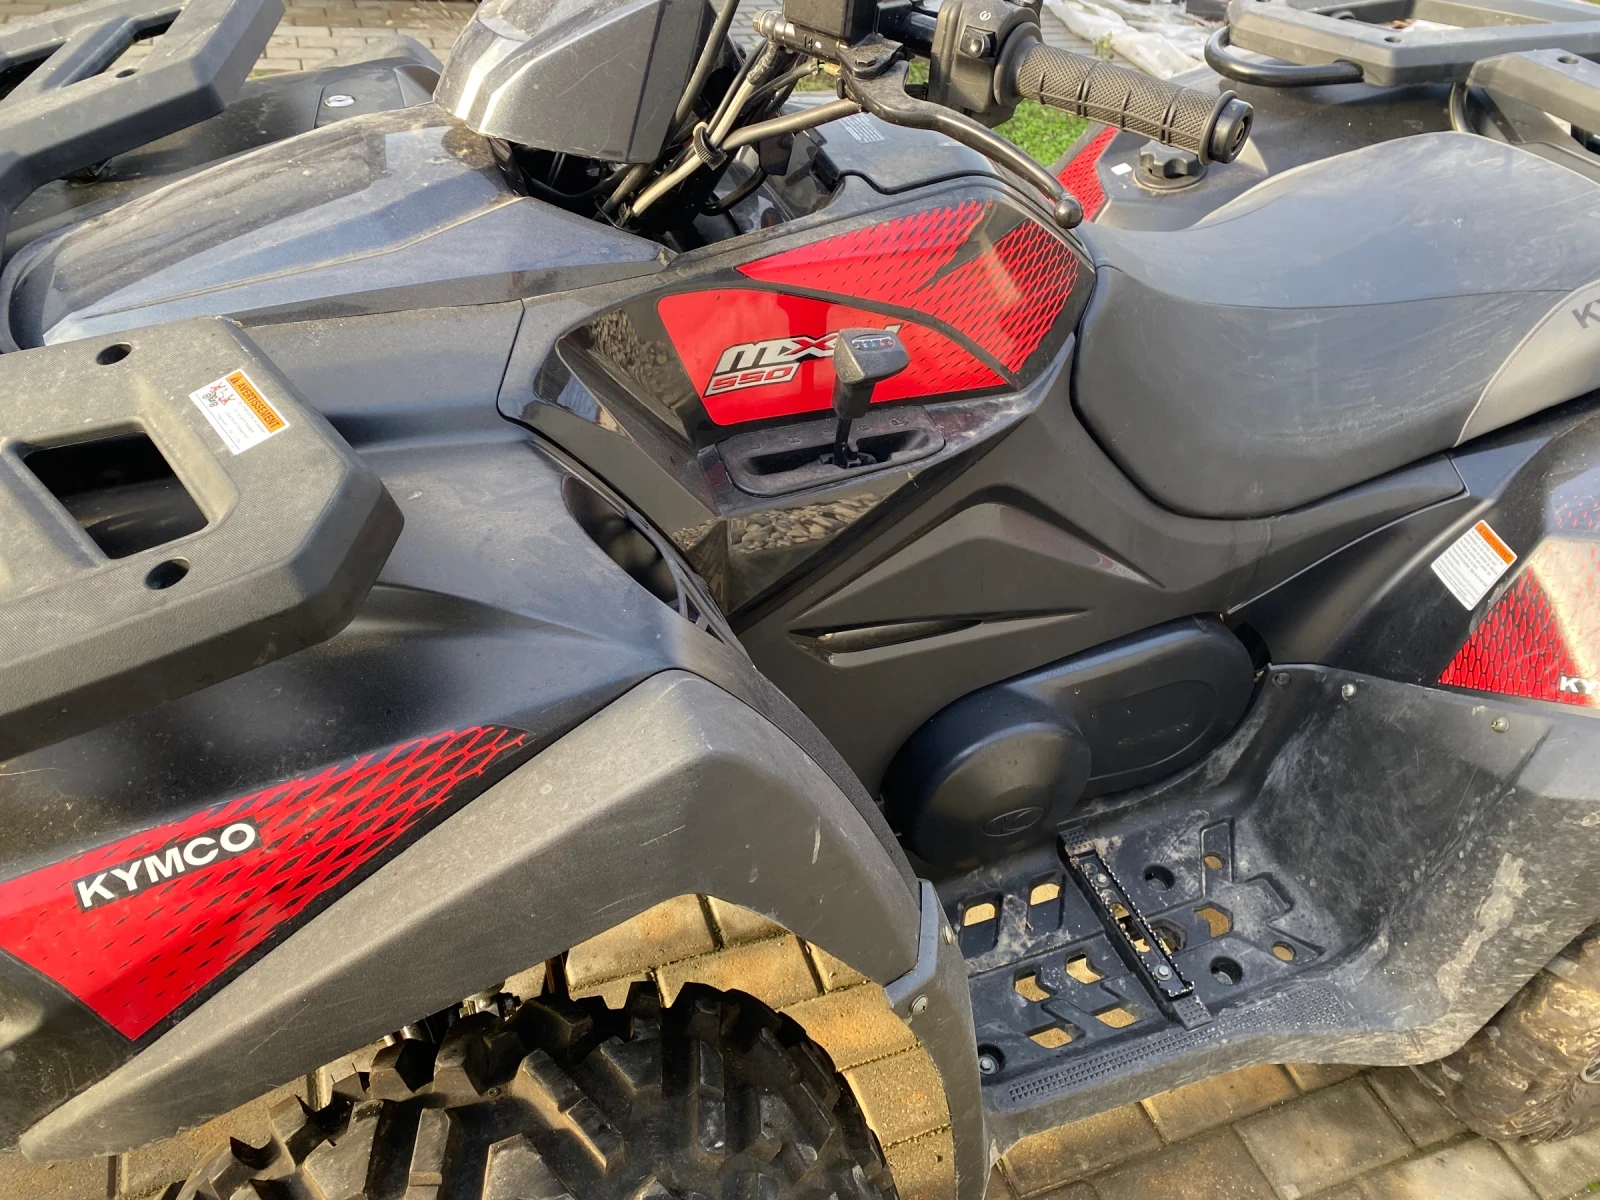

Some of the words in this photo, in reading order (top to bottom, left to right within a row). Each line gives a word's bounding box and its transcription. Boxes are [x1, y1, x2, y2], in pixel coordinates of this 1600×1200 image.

[711, 366, 793, 390] 550
[236, 382, 281, 429] AVERTISSEMENT
[76, 823, 256, 908] KYMCO
